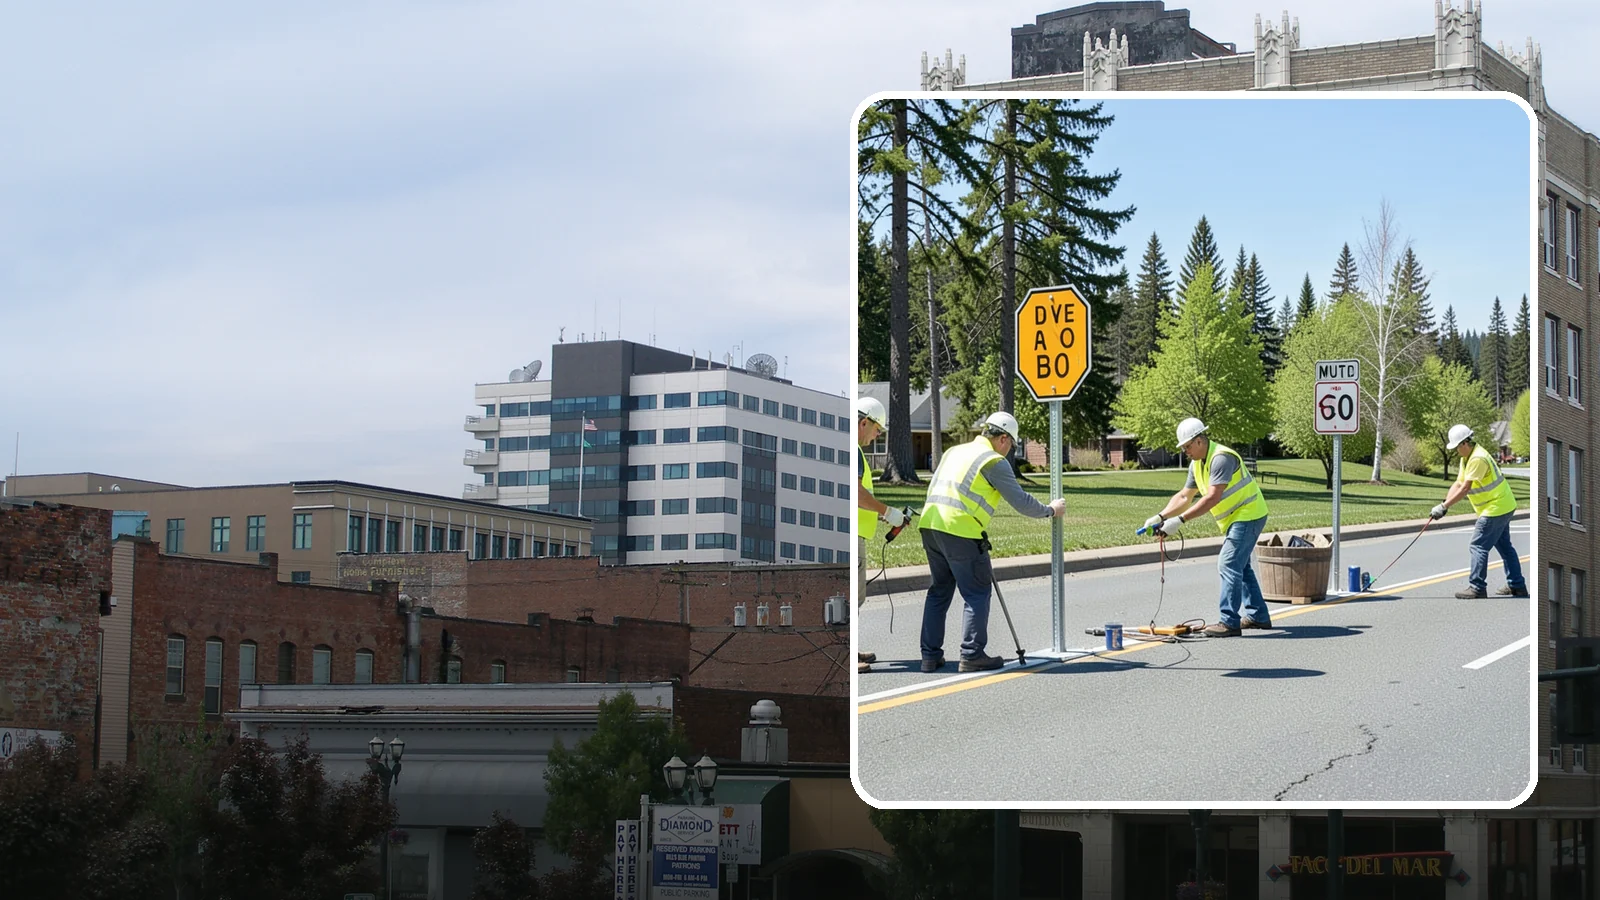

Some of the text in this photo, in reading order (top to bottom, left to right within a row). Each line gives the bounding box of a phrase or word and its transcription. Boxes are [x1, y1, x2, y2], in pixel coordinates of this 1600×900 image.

[1035, 303, 1075, 325] DVE
[1036, 352, 1070, 379] BO
[1318, 394, 1354, 421] 60
[343, 566, 427, 577] Home Furnishers
[660, 818, 713, 832] DIAMOND
[1021, 815, 1069, 828] BUILDING
[656, 845, 688, 853] RESERVED
[616, 825, 625, 893] PAY HERE
[627, 825, 637, 893] PAY HERE
[721, 851, 739, 863] Soup
[671, 862, 701, 870] PATRONS
[1346, 856, 1385, 875] DEL
[1392, 857, 1442, 877] MAR
[660, 889, 710, 898] PUBLIC PARKING
